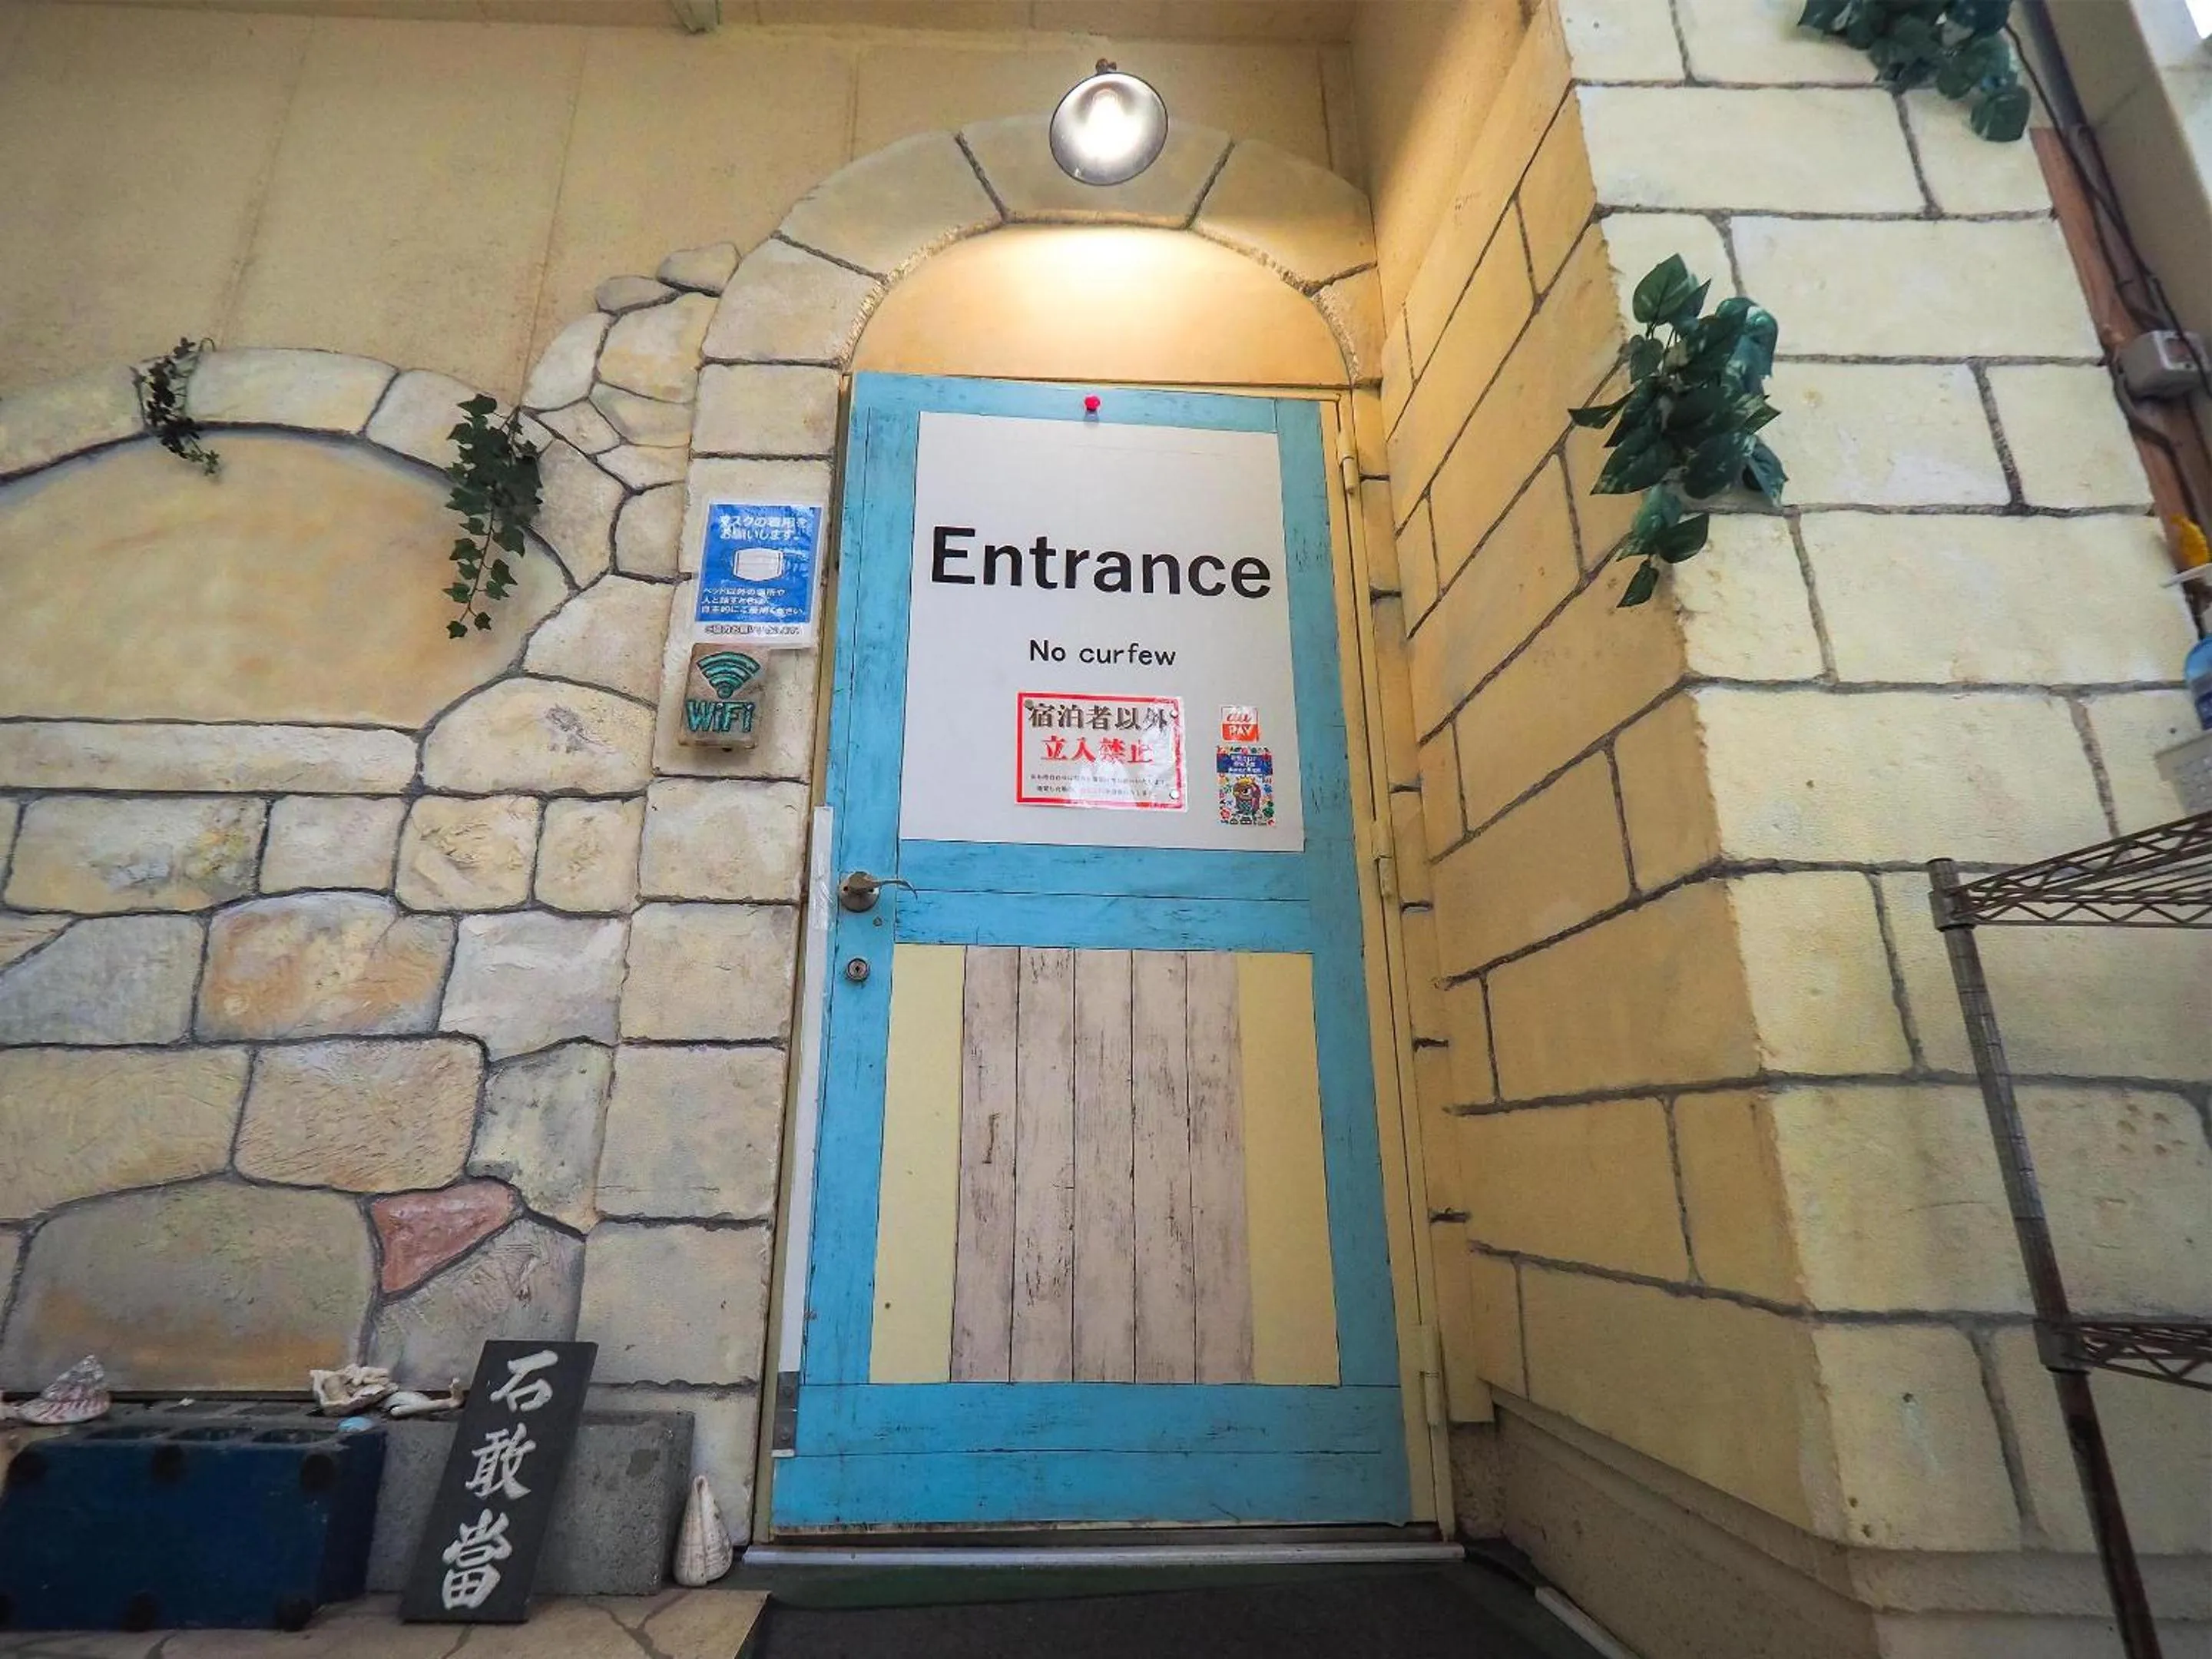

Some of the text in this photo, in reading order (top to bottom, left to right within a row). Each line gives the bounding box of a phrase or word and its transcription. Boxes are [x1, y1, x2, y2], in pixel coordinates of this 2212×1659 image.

[932, 526, 1270, 598] Entrance
[1031, 640, 1175, 665] No curfew
[1030, 704, 1167, 731] 宿泊者以外
[1041, 735, 1154, 763] 立入禁止
[441, 1349, 559, 1610] 石敢當
